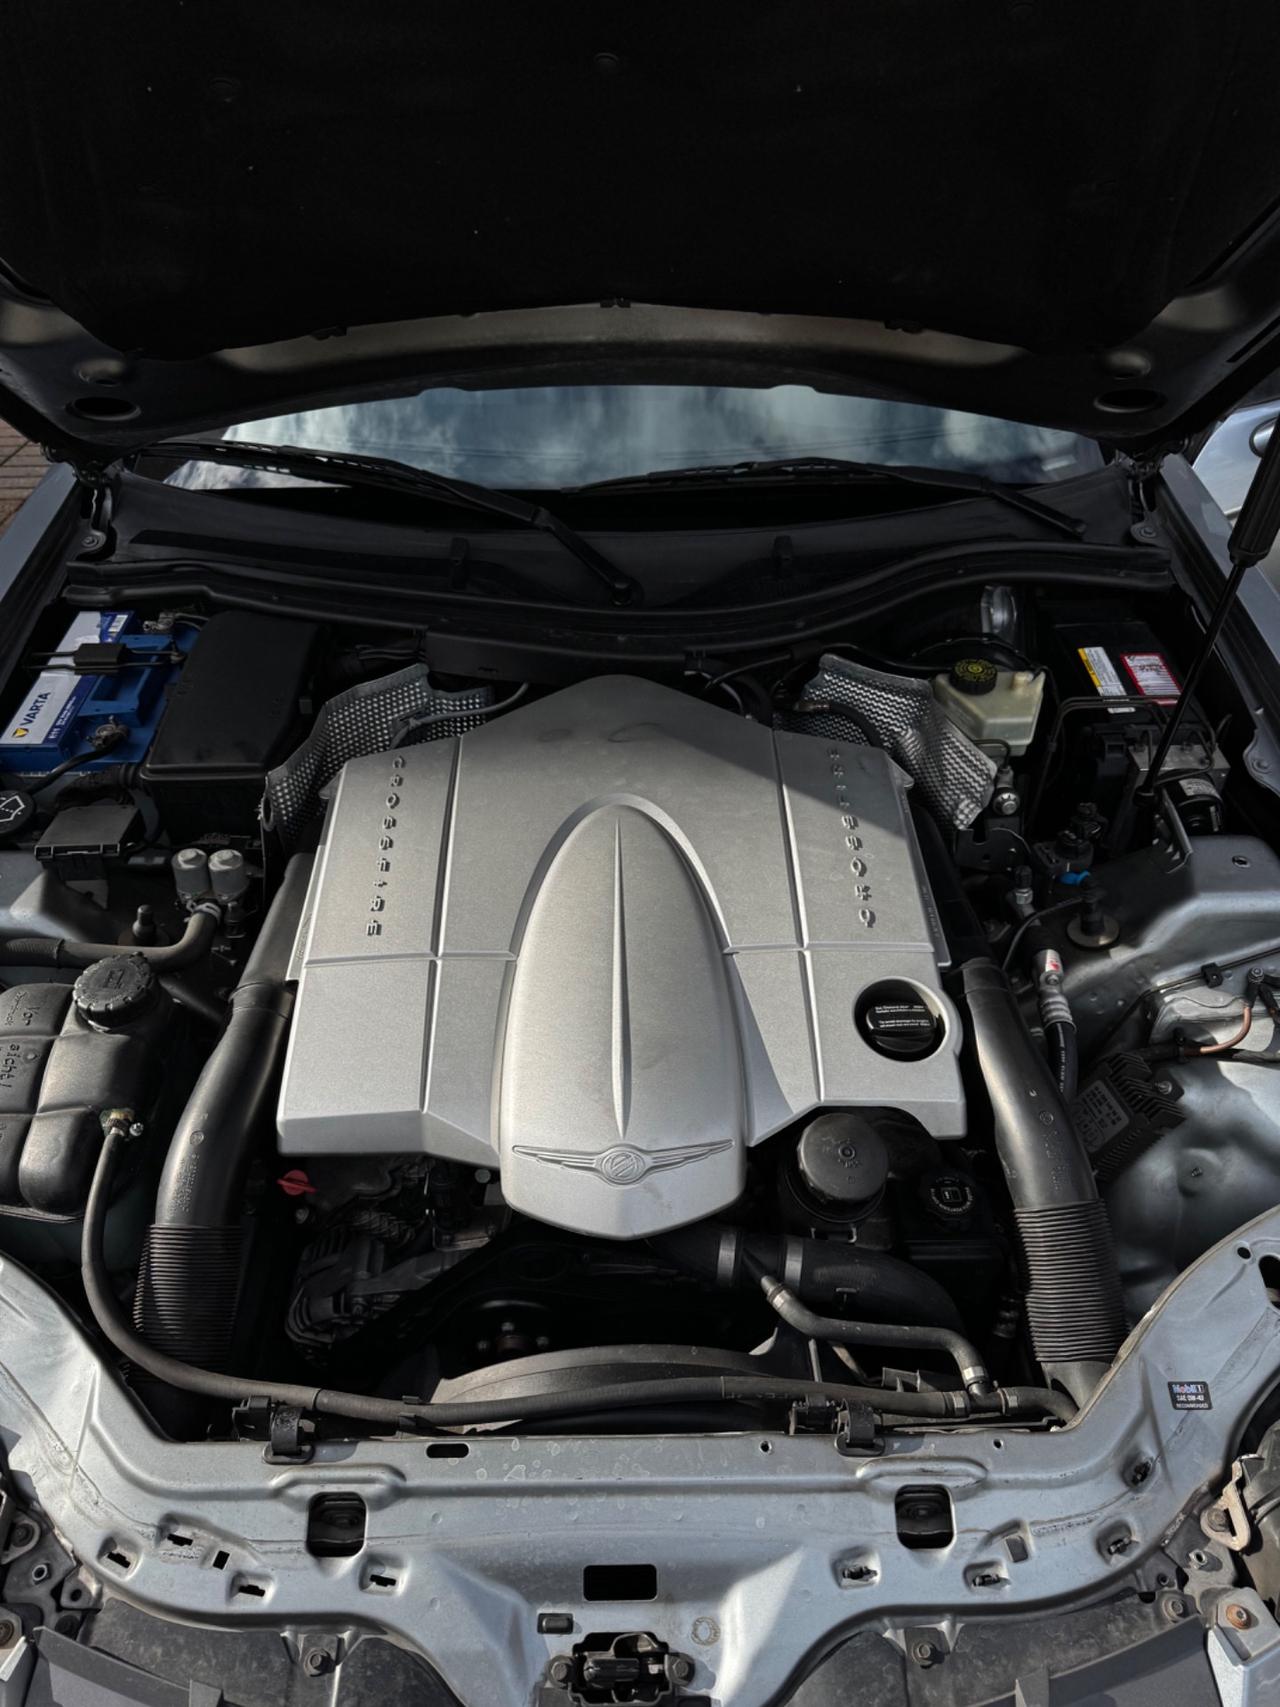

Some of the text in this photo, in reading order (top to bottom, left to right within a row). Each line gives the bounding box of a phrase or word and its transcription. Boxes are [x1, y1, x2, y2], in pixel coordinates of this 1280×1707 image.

[20, 692, 51, 725] VARTA
[366, 755, 406, 937] CROSSFIRE
[827, 747, 874, 928] CROSSFIRE
